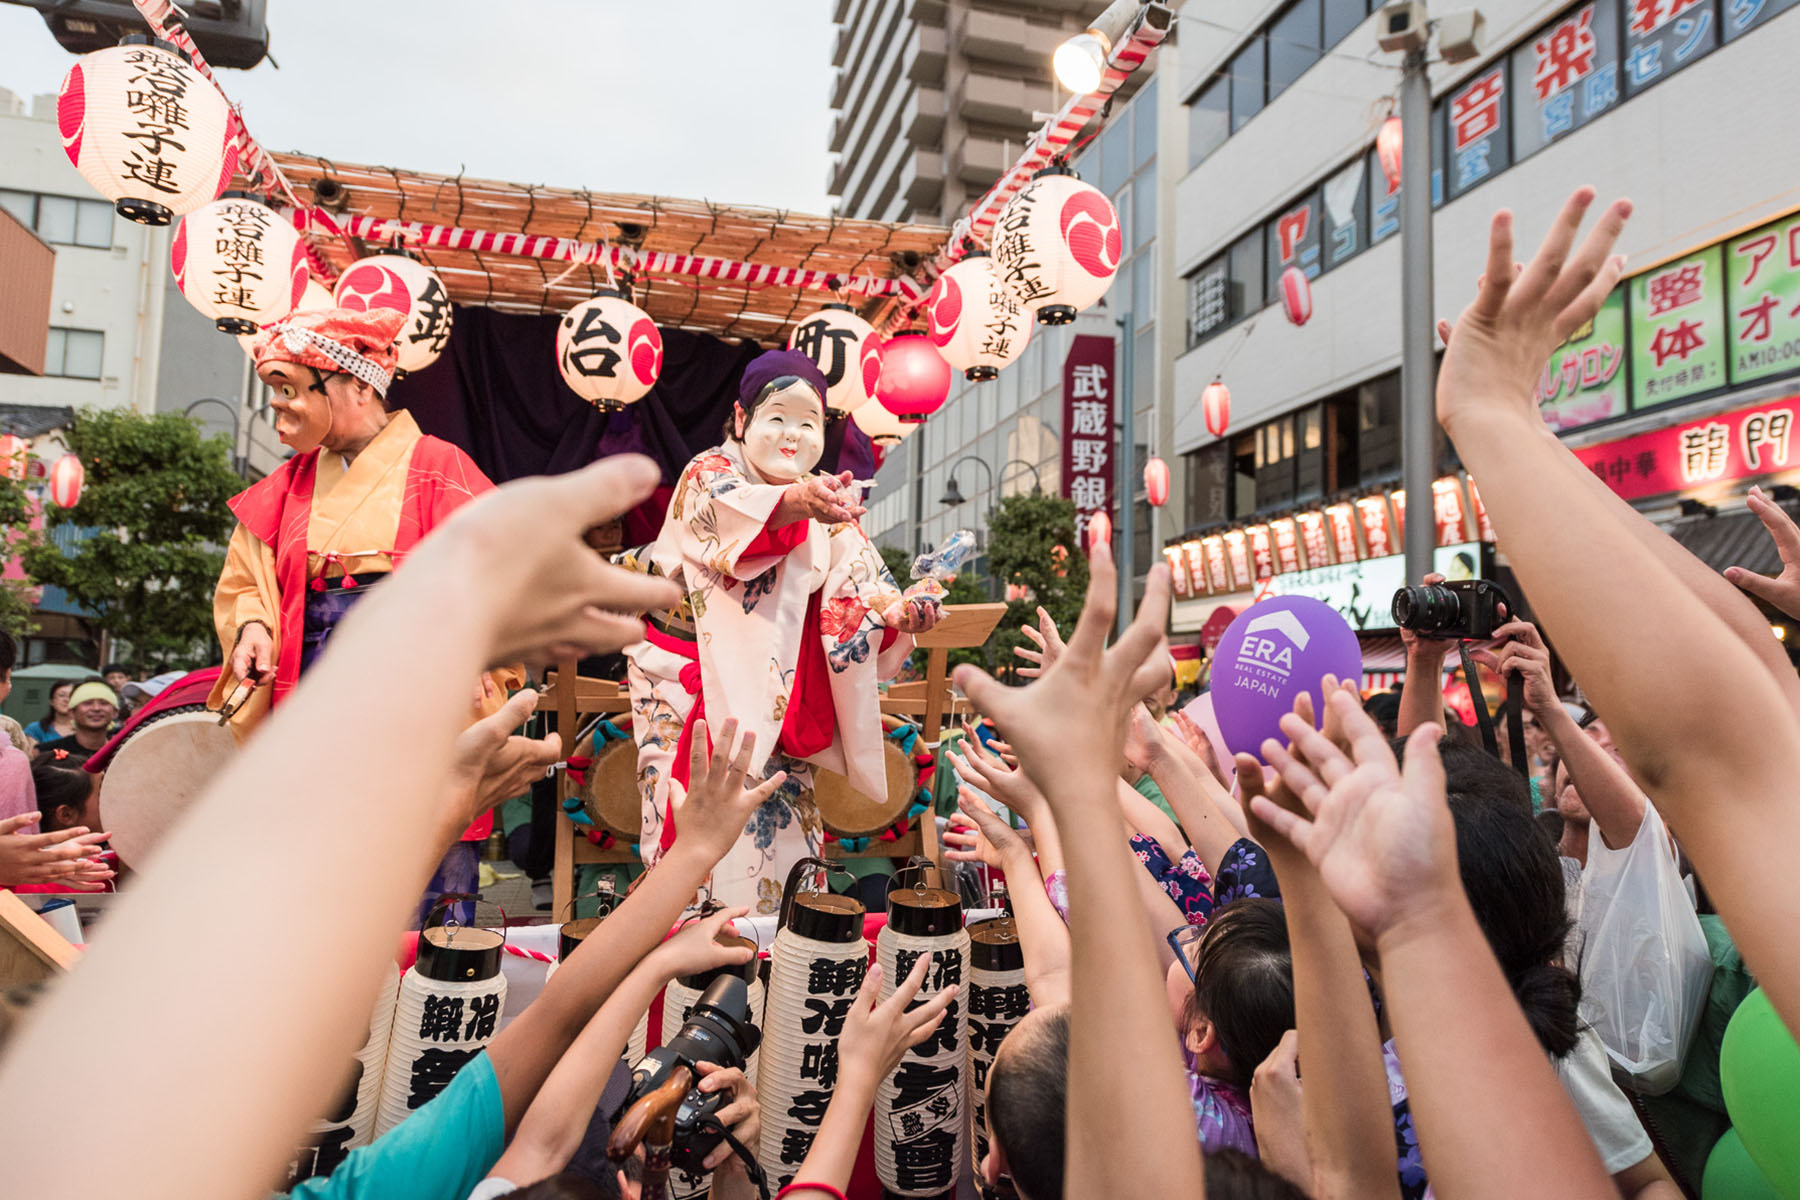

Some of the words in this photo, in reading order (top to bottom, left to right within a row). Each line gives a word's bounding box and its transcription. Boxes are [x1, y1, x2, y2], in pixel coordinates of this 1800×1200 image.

[979, 262, 1021, 359] 囃子連
[1648, 263, 1706, 368] 整体
[795, 318, 859, 389] 町
[1537, 343, 1623, 402] しサロン
[1679, 408, 1793, 484] 龍門
[1234, 663, 1254, 675] REAL
[1255, 668, 1288, 686] ESTATE
[1239, 635, 1293, 670] ERA
[1234, 675, 1280, 699] JAPAN
